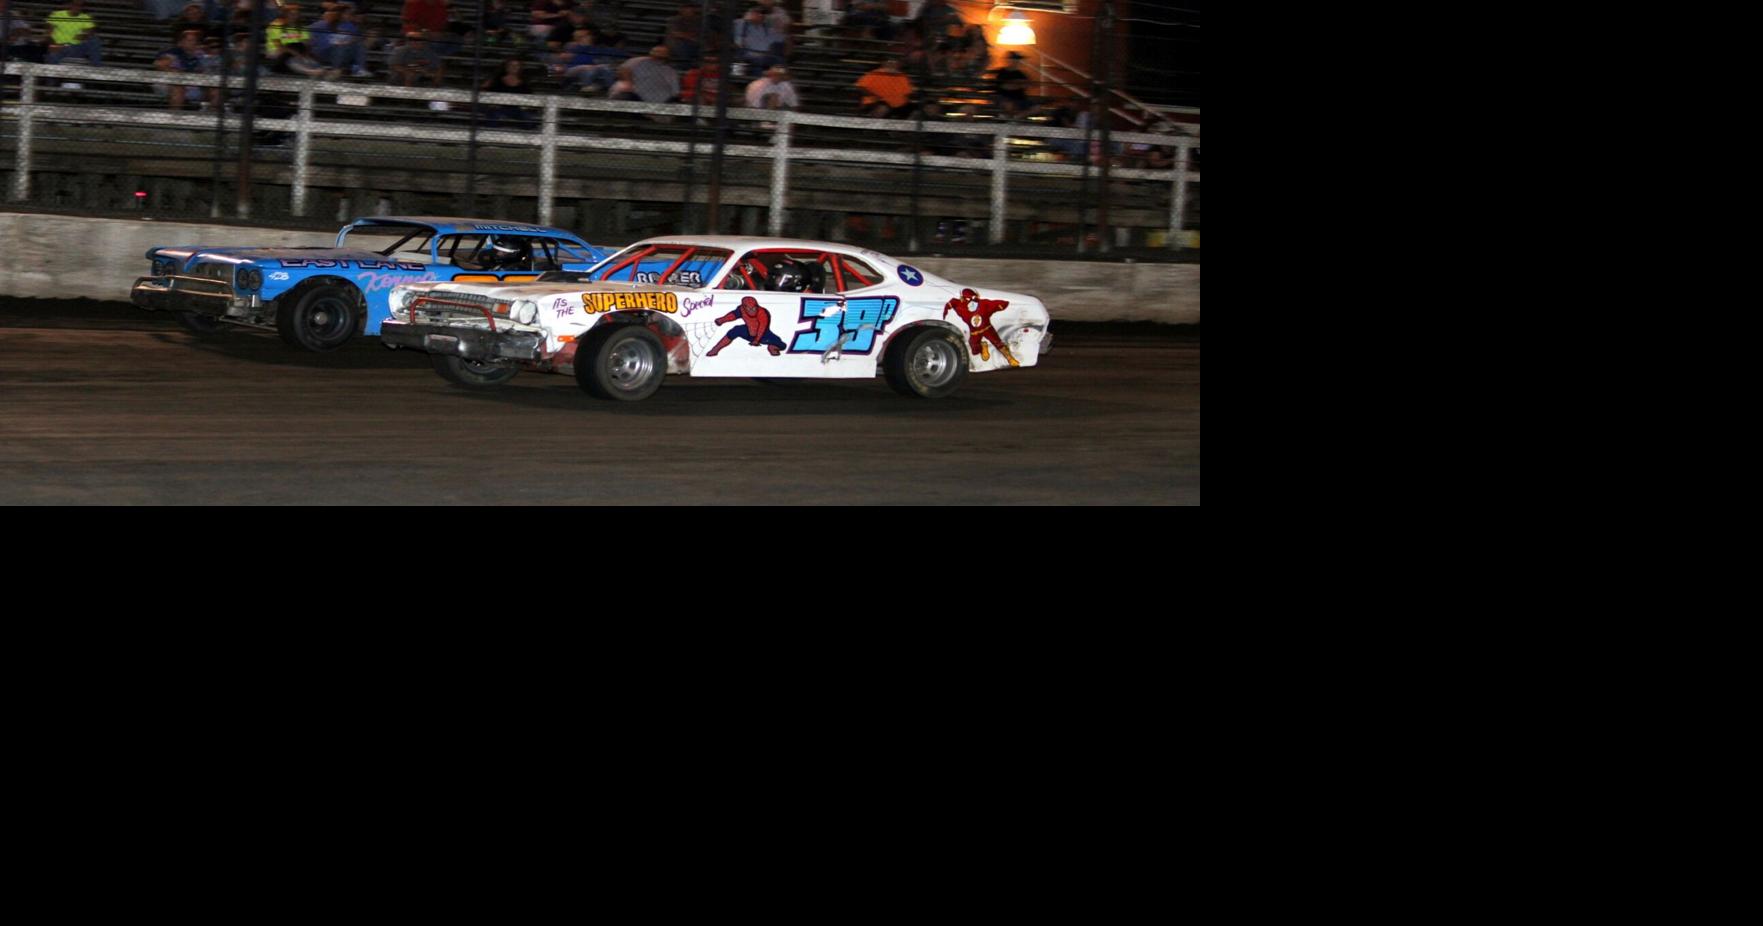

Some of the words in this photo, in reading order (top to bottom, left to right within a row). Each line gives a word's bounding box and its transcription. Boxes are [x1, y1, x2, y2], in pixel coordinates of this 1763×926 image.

[556, 306, 575, 319] THE
[581, 292, 678, 314] SUPERHERO
[680, 294, 714, 317] Special
